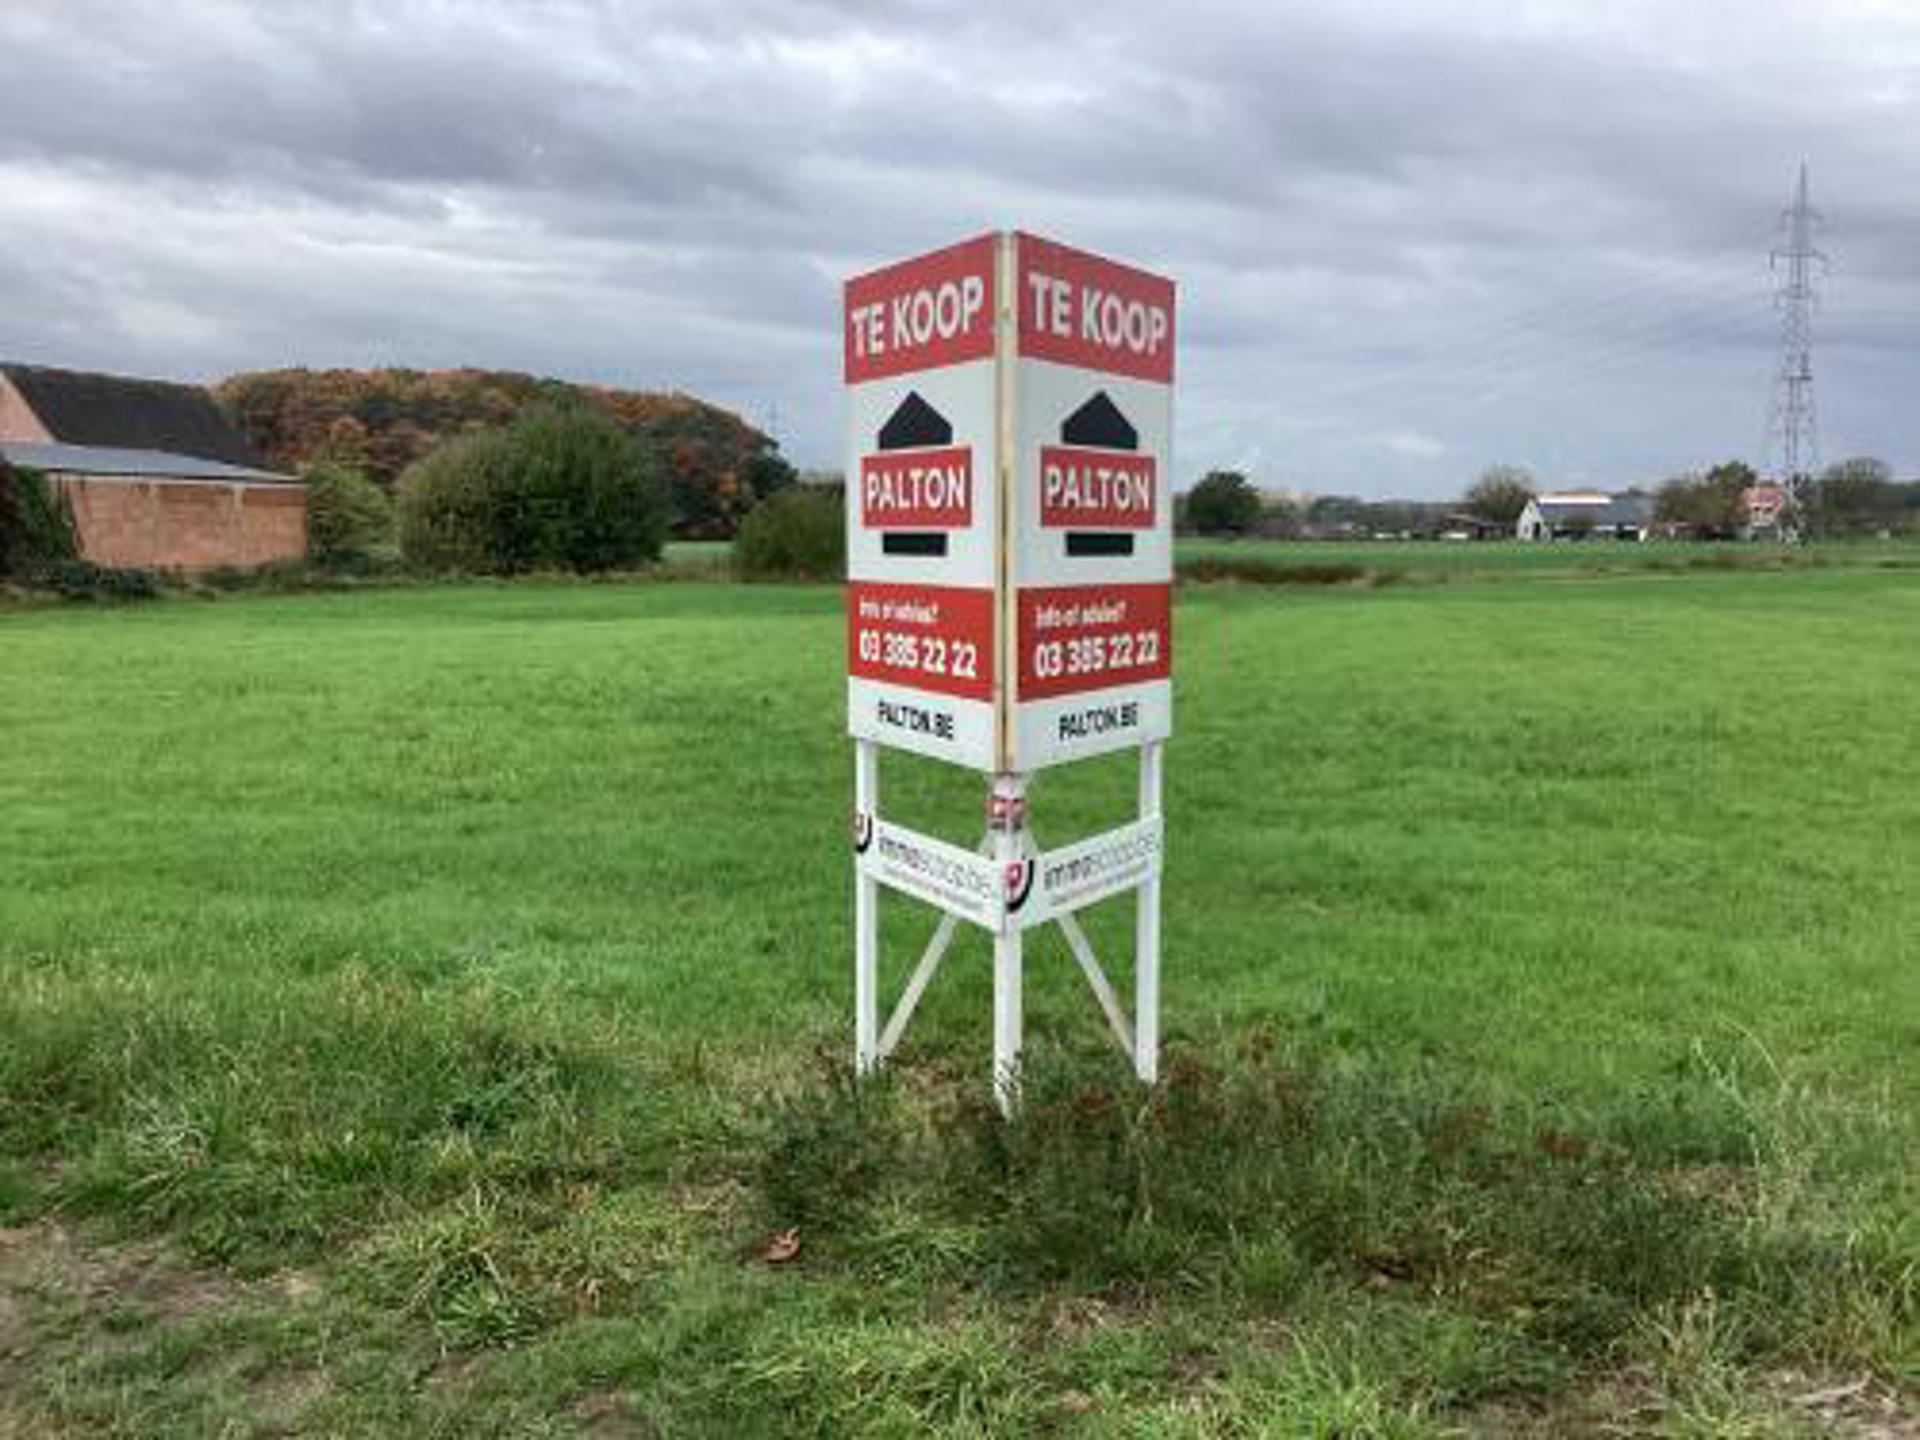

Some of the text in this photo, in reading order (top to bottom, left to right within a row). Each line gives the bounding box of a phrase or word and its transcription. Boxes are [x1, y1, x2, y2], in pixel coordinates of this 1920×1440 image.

[852, 275, 984, 358] TE KOOP
[1028, 272, 1167, 353] TE KOOP
[866, 466, 966, 509] PALTON
[1045, 466, 1150, 512] PALTON
[860, 629, 977, 678] 03 385 22 22
[1035, 629, 1159, 678] 03 385 22 22
[878, 699, 954, 740] PALTON.BE
[1058, 702, 1138, 741] PALTON.BE
